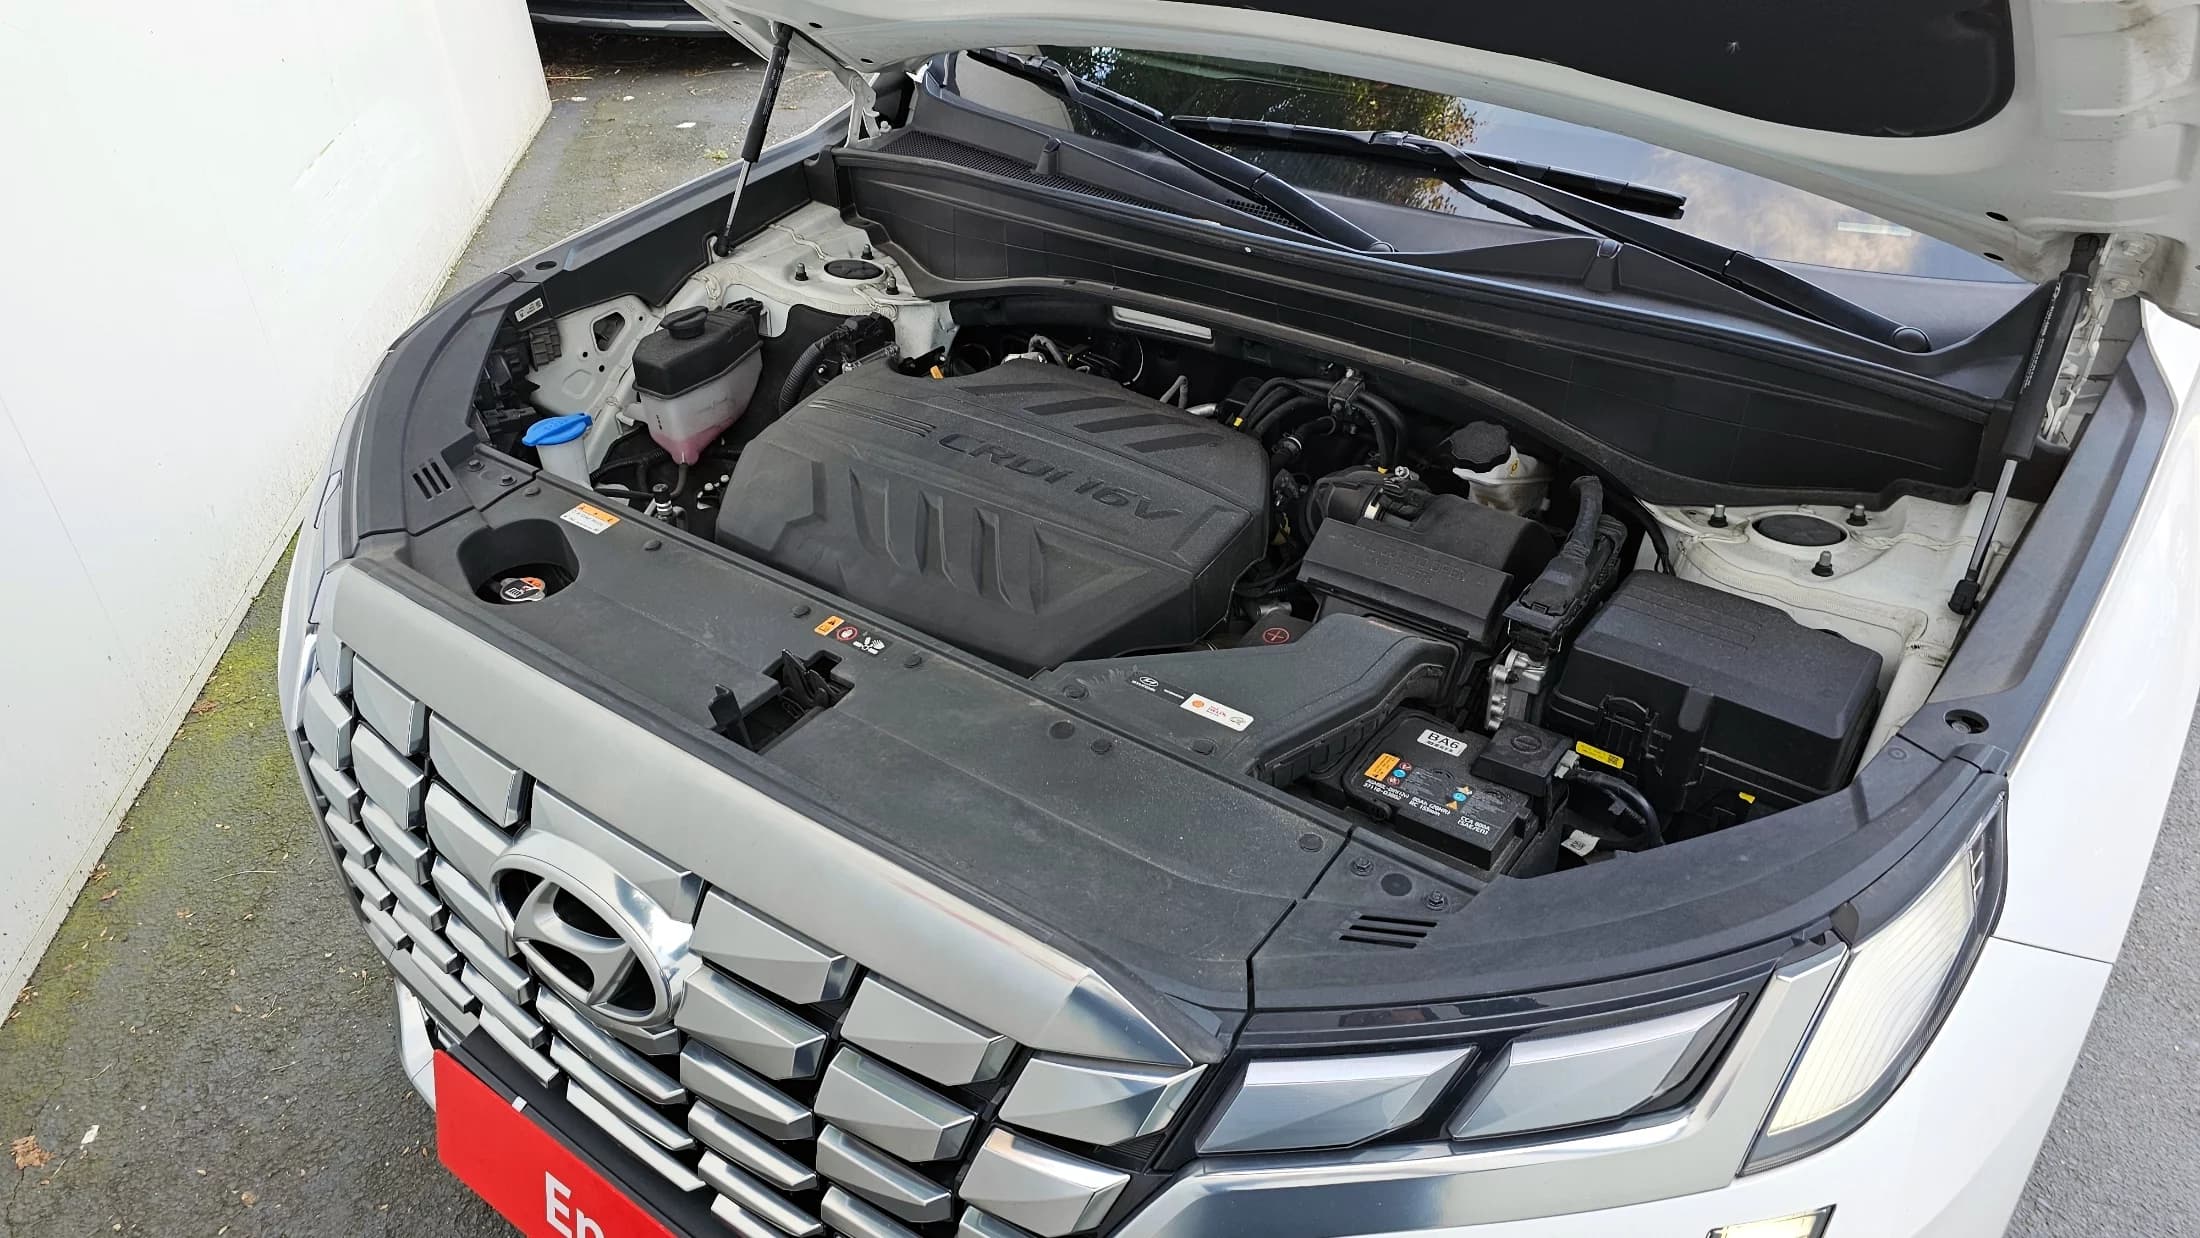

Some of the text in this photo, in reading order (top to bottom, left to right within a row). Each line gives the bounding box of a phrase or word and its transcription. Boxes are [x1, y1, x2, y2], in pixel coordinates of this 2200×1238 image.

[1073, 479, 1184, 520] 16V
[1427, 732, 1460, 749] BA6
[1460, 815, 1474, 825] CCA
